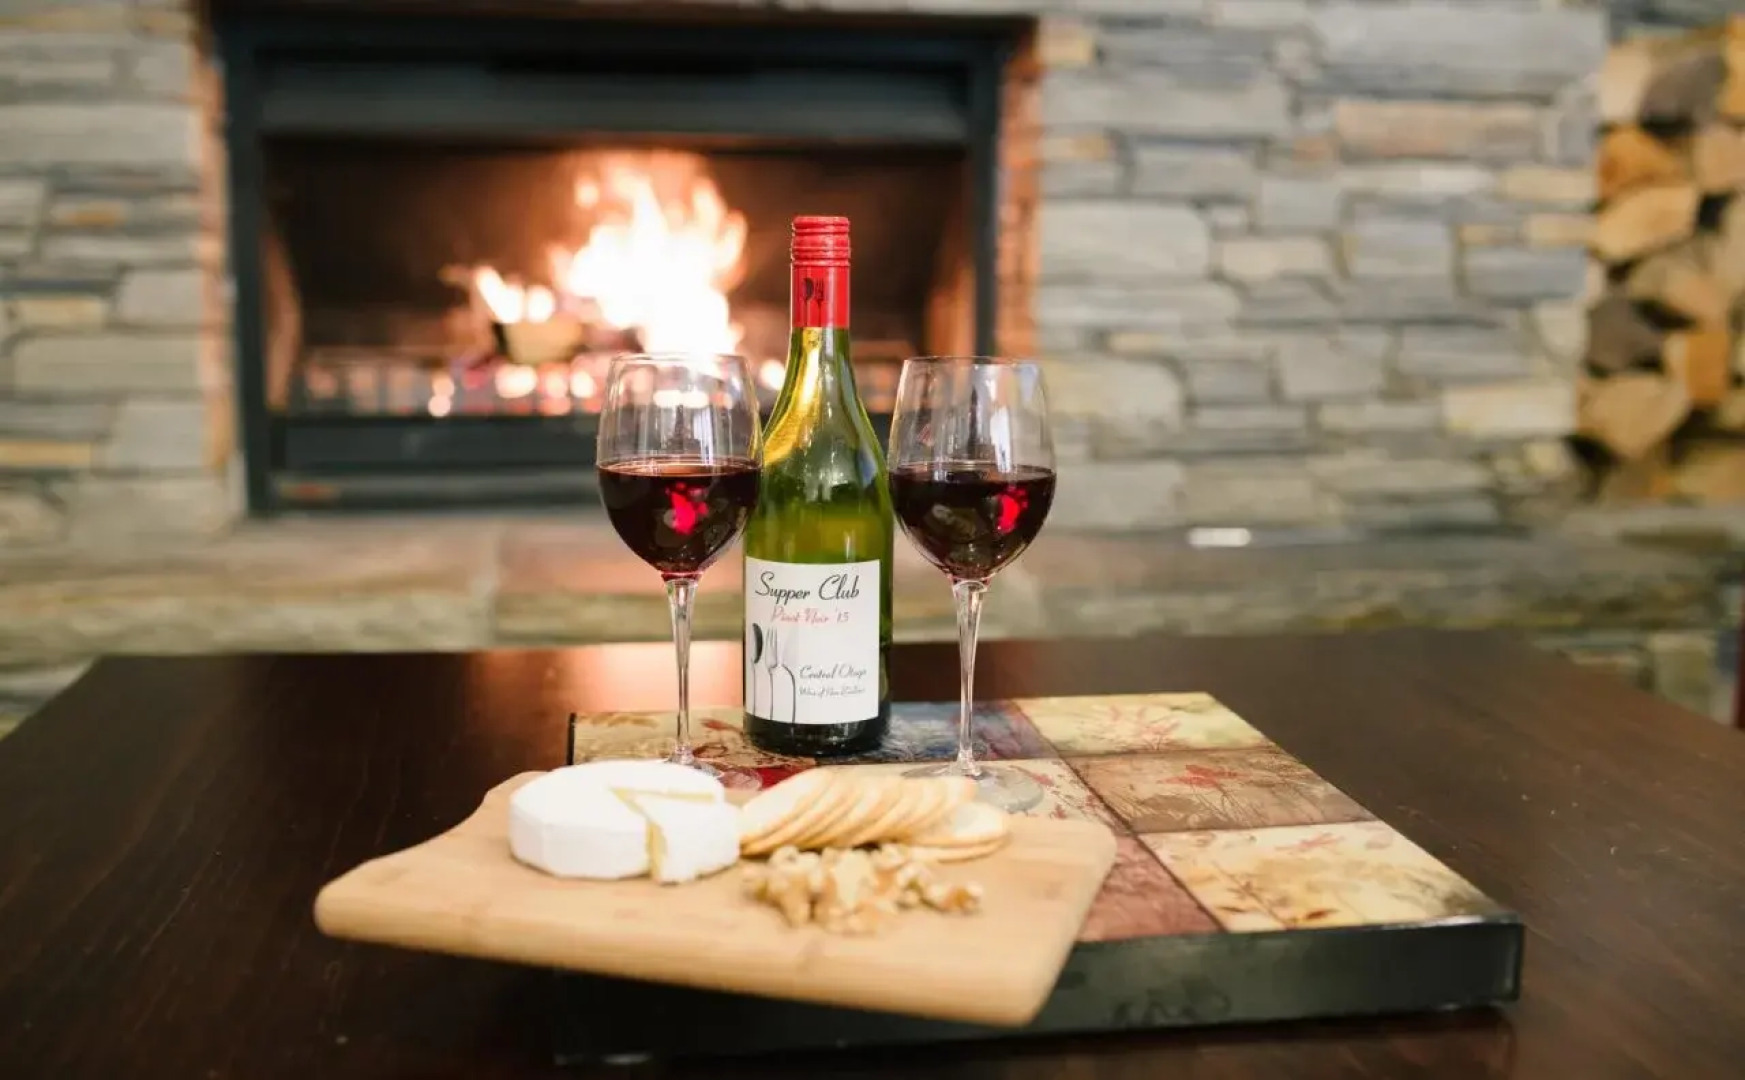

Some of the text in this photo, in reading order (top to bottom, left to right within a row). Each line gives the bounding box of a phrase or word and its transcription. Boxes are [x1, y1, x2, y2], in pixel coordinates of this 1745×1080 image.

[755, 571, 860, 605] Supper Club
[772, 605, 800, 622] Pinot
[804, 607, 829, 623] Noir
